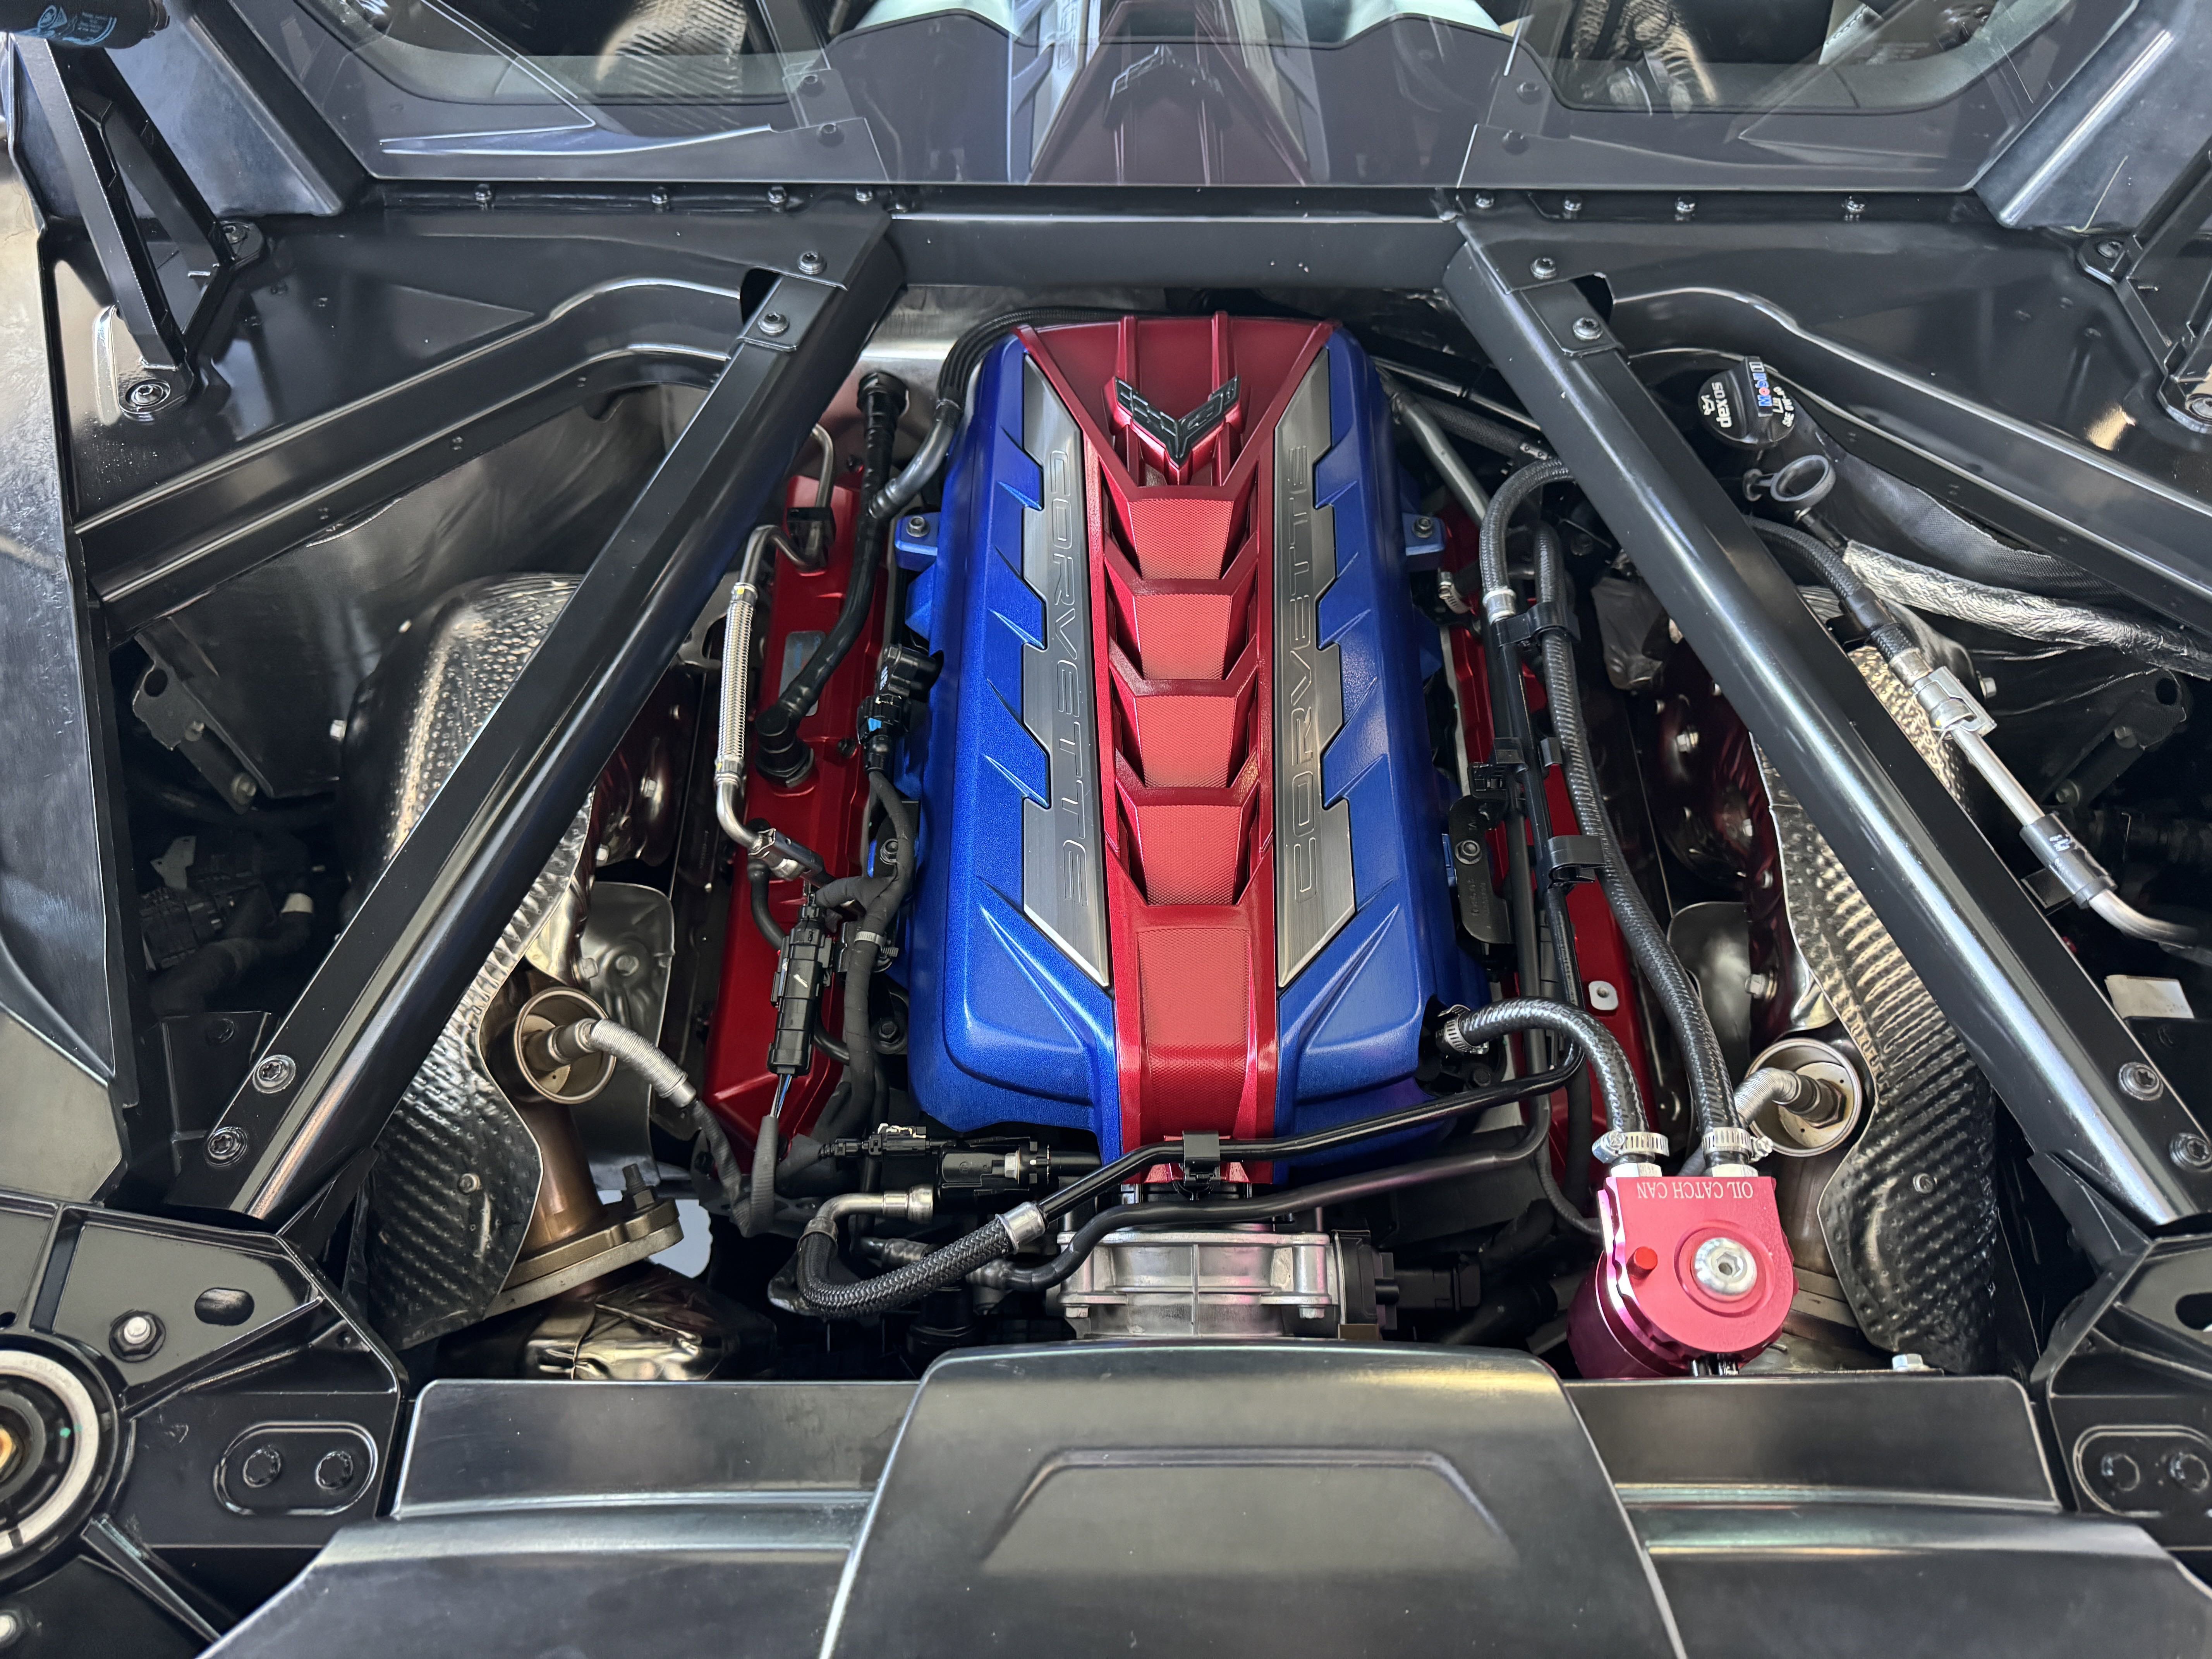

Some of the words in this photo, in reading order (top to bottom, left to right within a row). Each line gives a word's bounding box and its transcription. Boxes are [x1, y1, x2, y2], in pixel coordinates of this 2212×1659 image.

[1752, 373, 1772, 407] Mobil
[1712, 381, 1732, 428] dexos
[1782, 411, 1795, 427] SAE
[1048, 450, 1088, 906] CORVETTE
[1288, 445, 1317, 903] CORVETTE
[1637, 1181, 1667, 1199] CAN
[1671, 1182, 1724, 1199] CATCH
[1726, 1181, 1753, 1199] OIL
